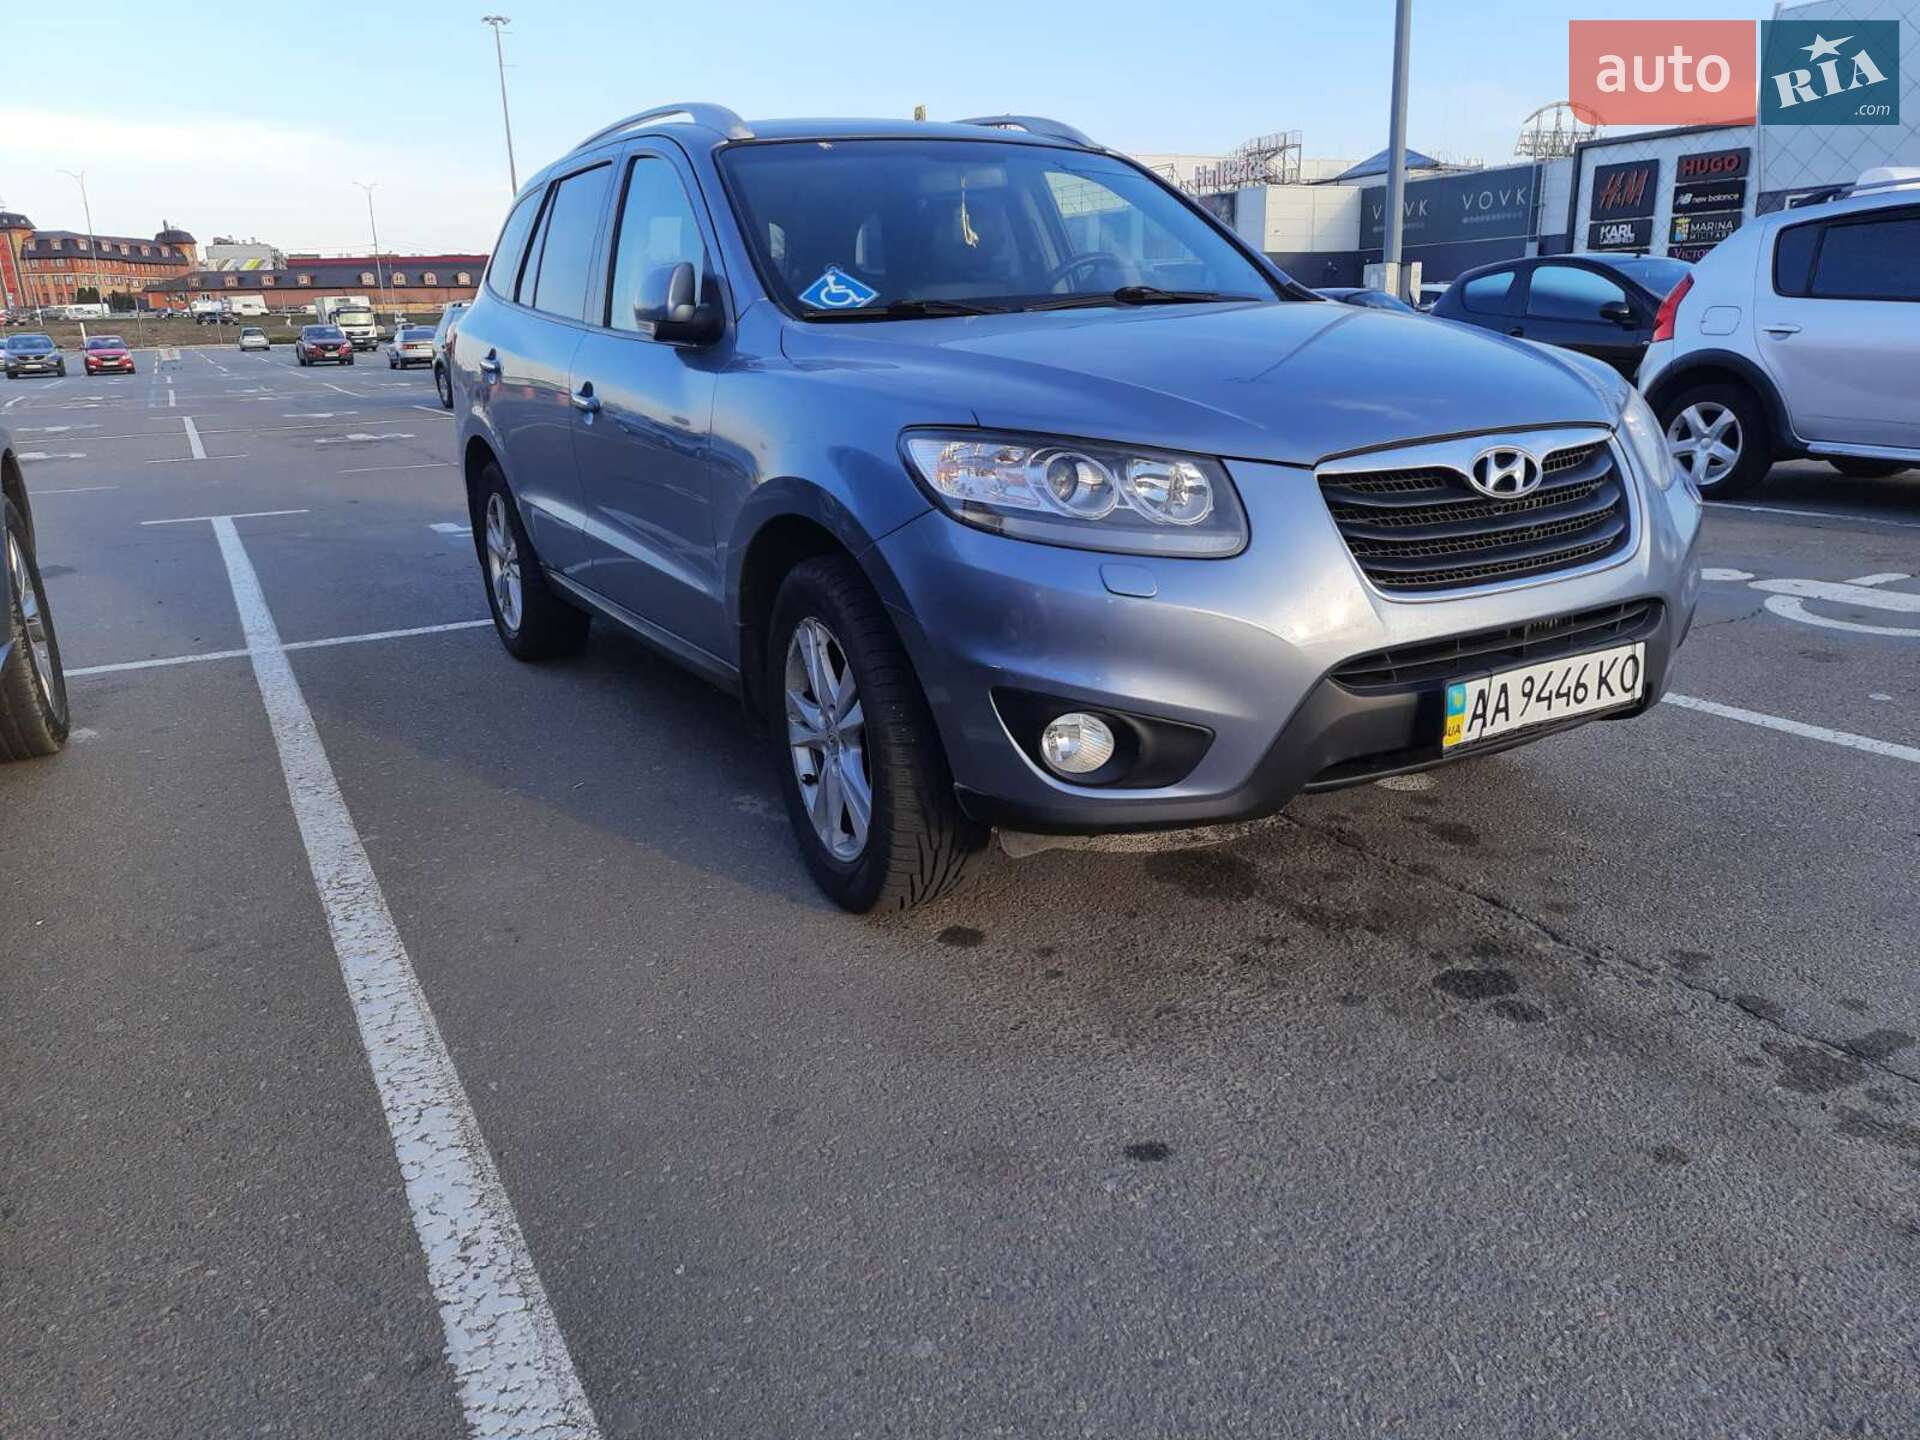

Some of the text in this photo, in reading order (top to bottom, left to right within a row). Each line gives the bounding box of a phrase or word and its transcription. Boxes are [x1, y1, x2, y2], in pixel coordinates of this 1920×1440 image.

[1684, 154, 1740, 174] HUGO
[1600, 167, 1648, 210] H&M
[1462, 186, 1527, 211] VOVK
[1708, 193, 1740, 203] balance
[1372, 199, 1428, 220] VVK
[1600, 224, 1633, 239] KARL
[1690, 220, 1734, 232] MARINA
[1690, 231, 1729, 241] MILITAR
[1673, 248, 1708, 259] VICTO
[1467, 654, 1640, 732] AA 9446 KO
[1448, 724, 1462, 737] UA
